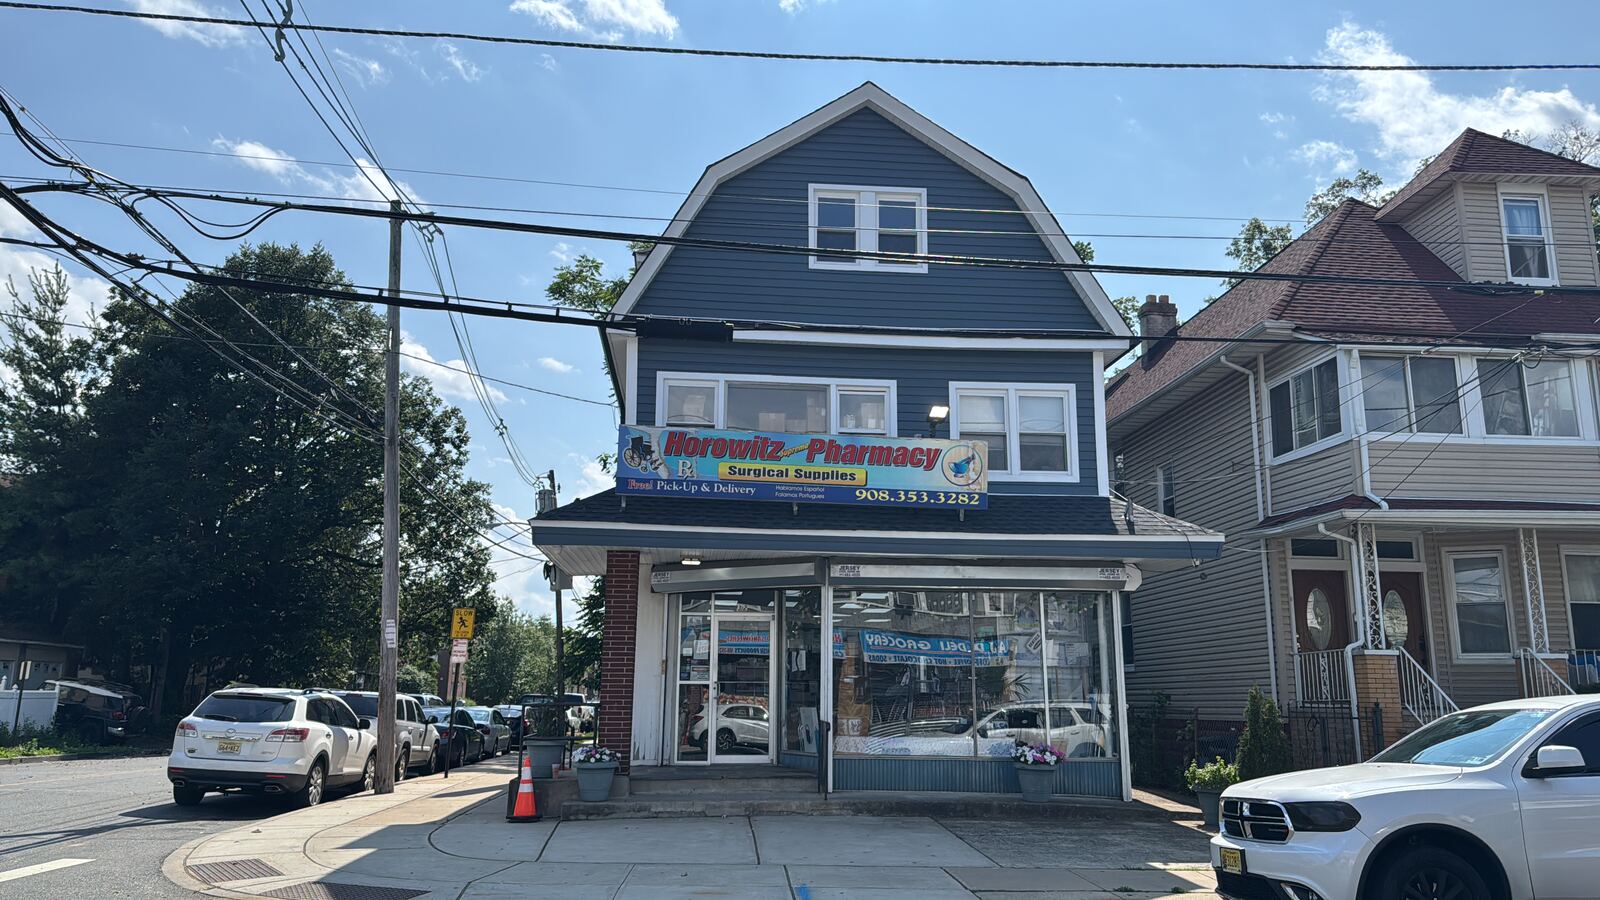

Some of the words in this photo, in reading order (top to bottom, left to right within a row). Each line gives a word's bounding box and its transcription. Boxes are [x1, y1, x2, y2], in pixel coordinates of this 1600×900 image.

[664, 431, 785, 461] Horowitz
[806, 438, 941, 471] Pharmacy
[728, 465, 789, 479] Surgical
[794, 468, 857, 481] Supplies
[657, 480, 698, 493] Pick-Up
[701, 485, 710, 493] &
[714, 484, 756, 495] Delivery
[855, 488, 980, 505] 908.353.3282
